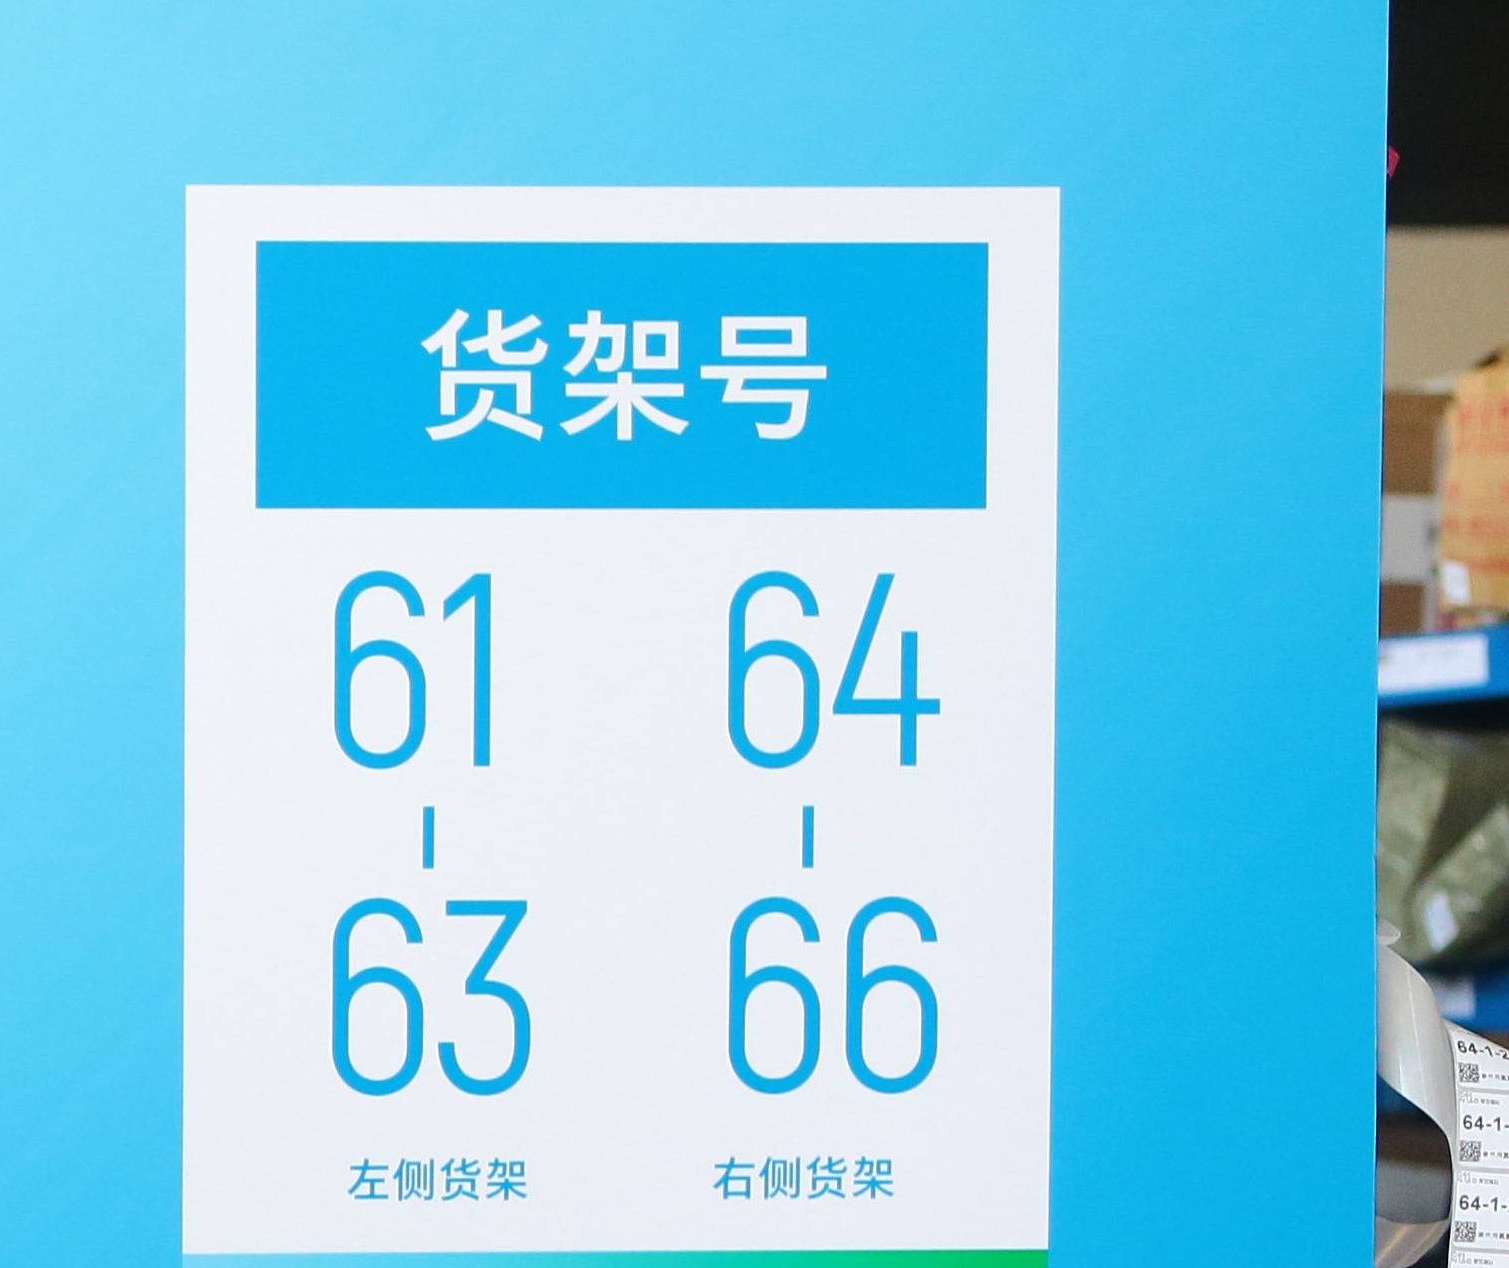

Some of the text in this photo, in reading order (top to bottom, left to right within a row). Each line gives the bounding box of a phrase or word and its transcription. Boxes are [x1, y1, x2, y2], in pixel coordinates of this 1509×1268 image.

[421, 308, 828, 441] 货架号
[334, 570, 492, 770] 61
[728, 570, 941, 769] 64
[332, 897, 531, 1097] 63
[728, 896, 938, 1095] 66
[348, 1157, 527, 1201] 左侧货架
[713, 1156, 894, 1199] 右侧货架
[1459, 1195, 1509, 1212] 64-1-
